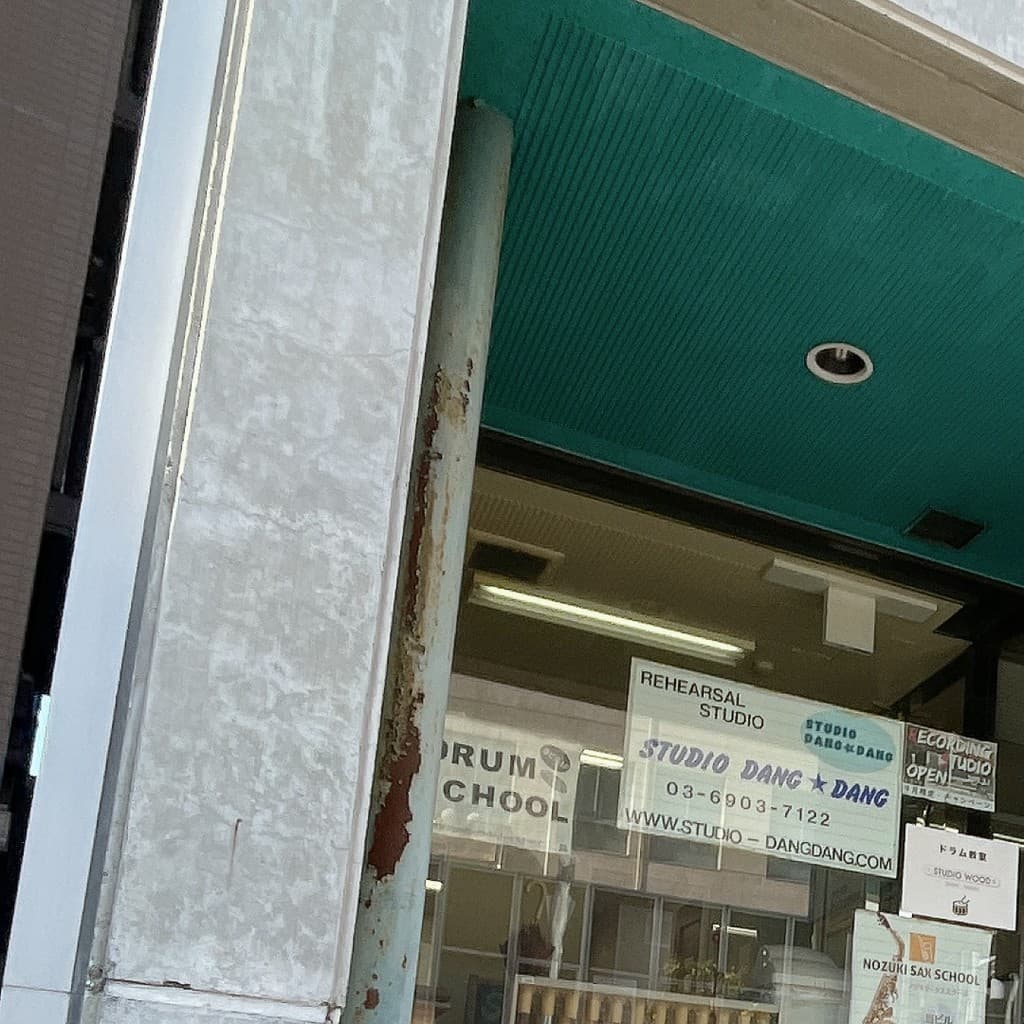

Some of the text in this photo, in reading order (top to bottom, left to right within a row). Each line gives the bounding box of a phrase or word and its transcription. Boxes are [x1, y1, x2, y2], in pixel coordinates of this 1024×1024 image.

[641, 671, 746, 708] REHEARSAL
[699, 703, 765, 730] STUDIO
[806, 719, 857, 740] STUDIO
[639, 738, 890, 808] STUDIO DANG DANG
[906, 763, 948, 786] OPEN
[443, 779, 568, 824] CHOOL
[666, 781, 831, 827] 03-6903-7122
[933, 866, 962, 879] STUDIO
[863, 958, 981, 986] NOZUKI SAX SCHOOL
